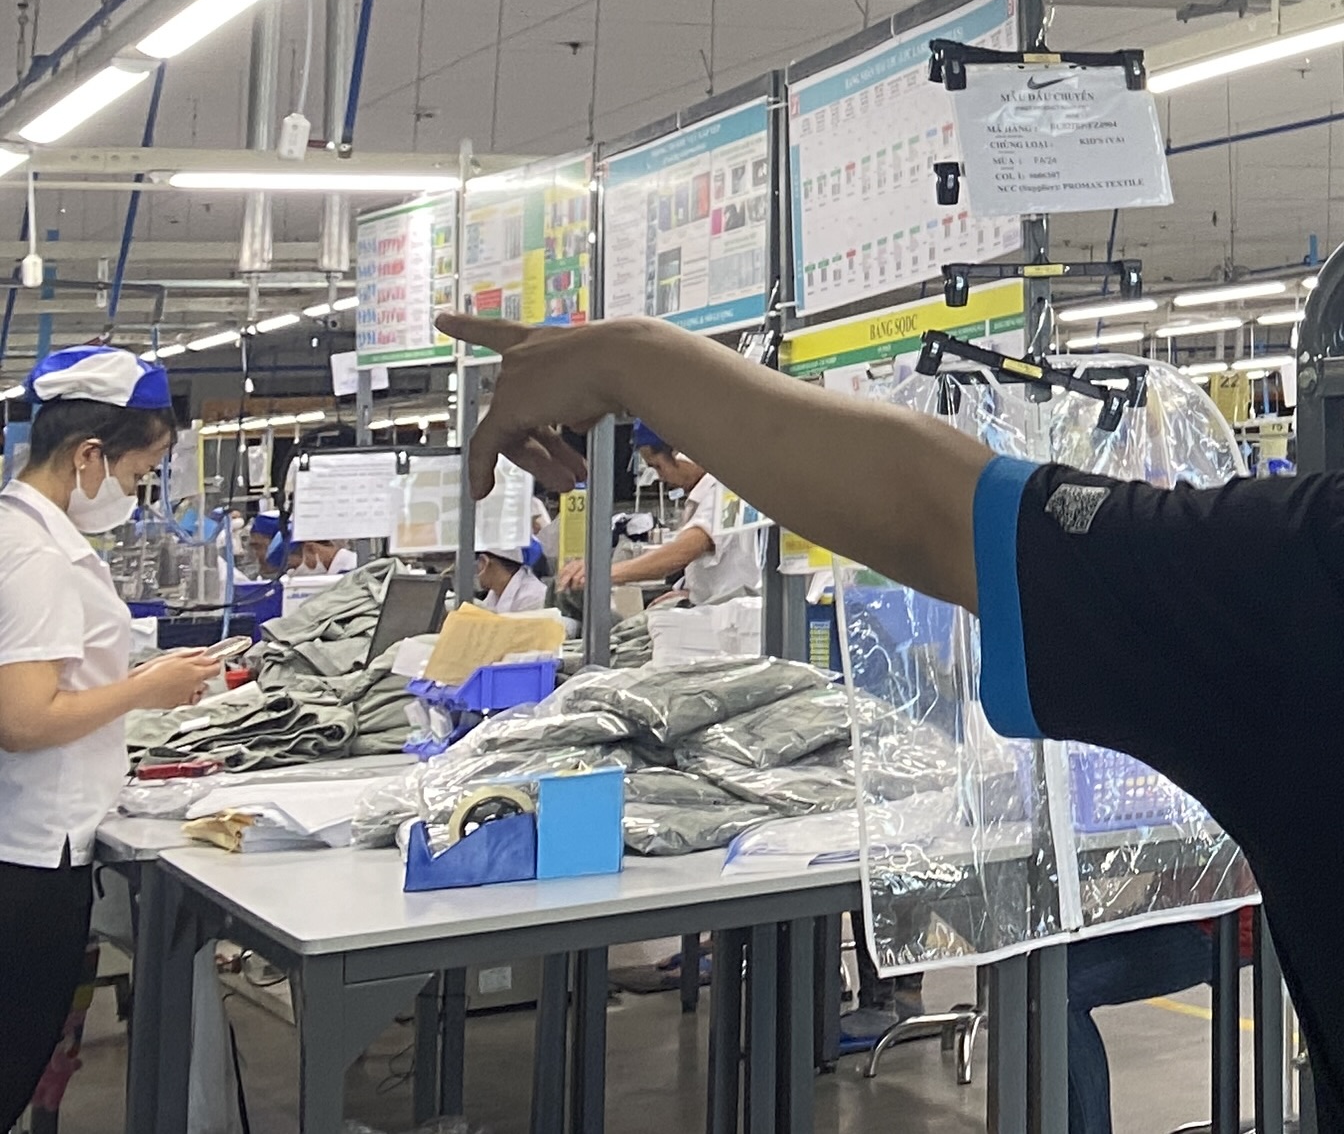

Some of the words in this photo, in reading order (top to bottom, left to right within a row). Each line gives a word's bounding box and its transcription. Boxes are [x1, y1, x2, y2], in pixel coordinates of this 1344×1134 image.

[893, 314, 918, 338] SQDC
[1220, 373, 1241, 389] 22
[567, 495, 586, 513] 33
